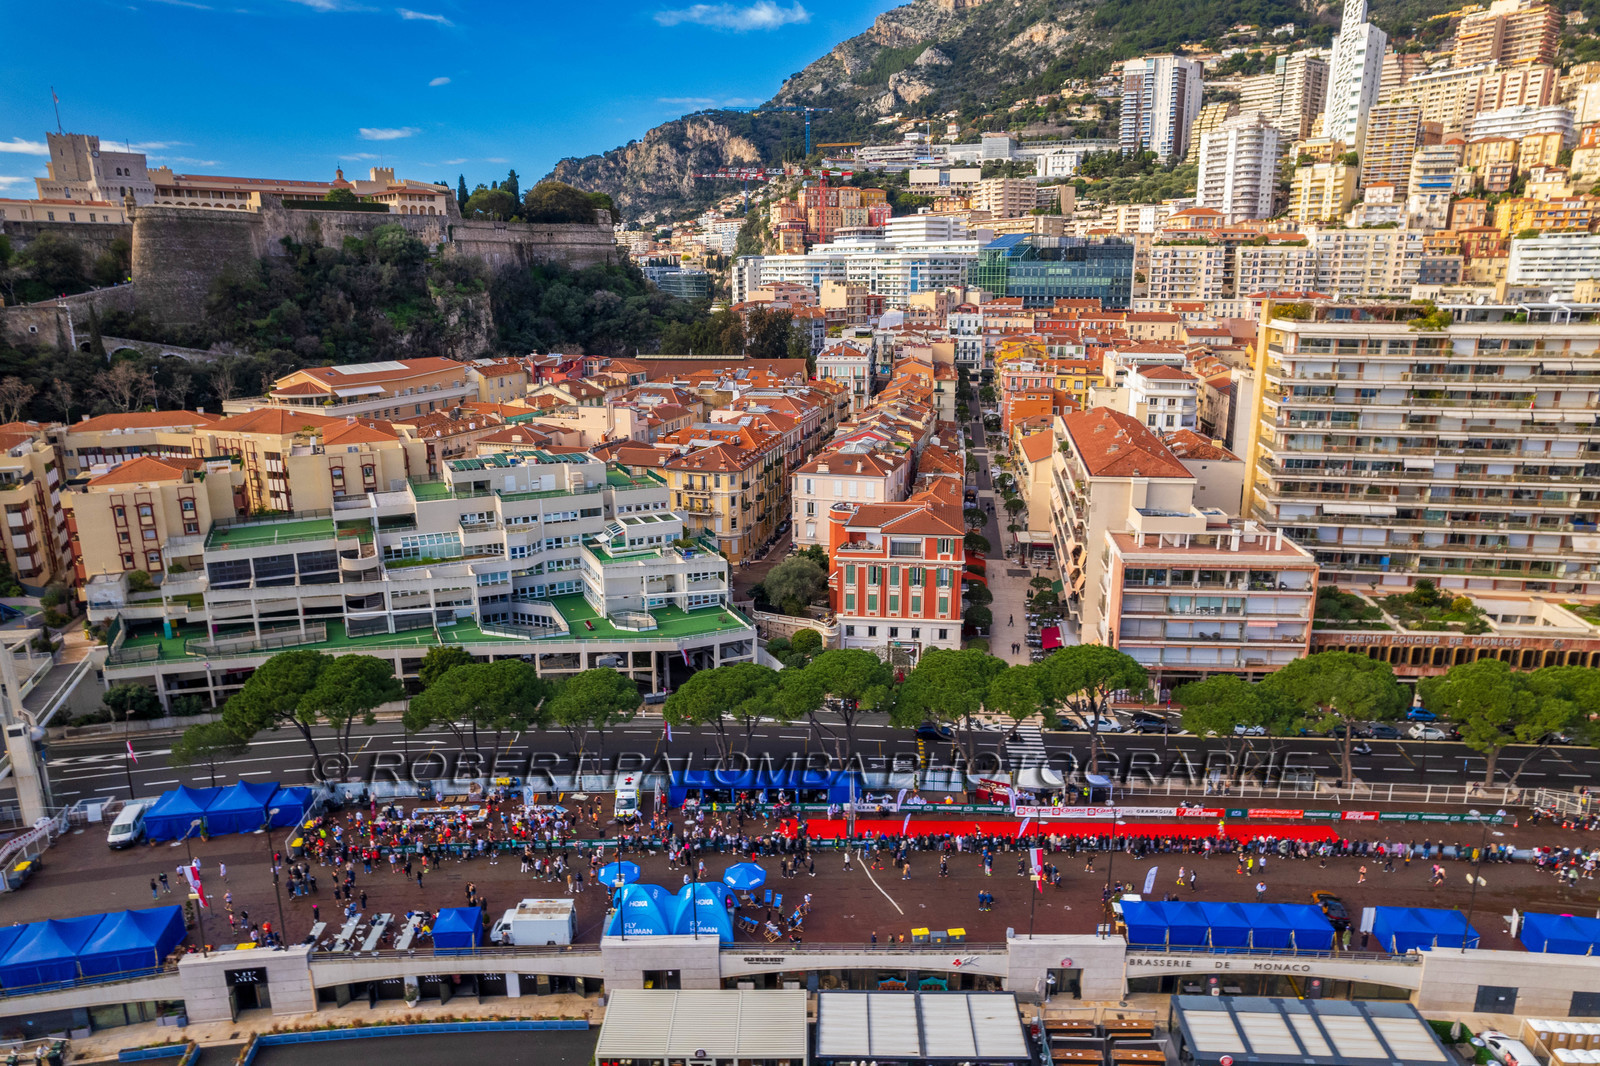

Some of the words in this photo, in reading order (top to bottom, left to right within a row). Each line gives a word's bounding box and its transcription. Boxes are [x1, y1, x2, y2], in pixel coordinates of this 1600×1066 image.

[1391, 636, 1441, 645] FONCIER
[1448, 637, 1464, 646] DE
[1471, 637, 1521, 647] MONACO
[1129, 958, 1193, 968] BRASSERIE
[1214, 961, 1231, 969] DE
[1253, 963, 1311, 972] MONACO
